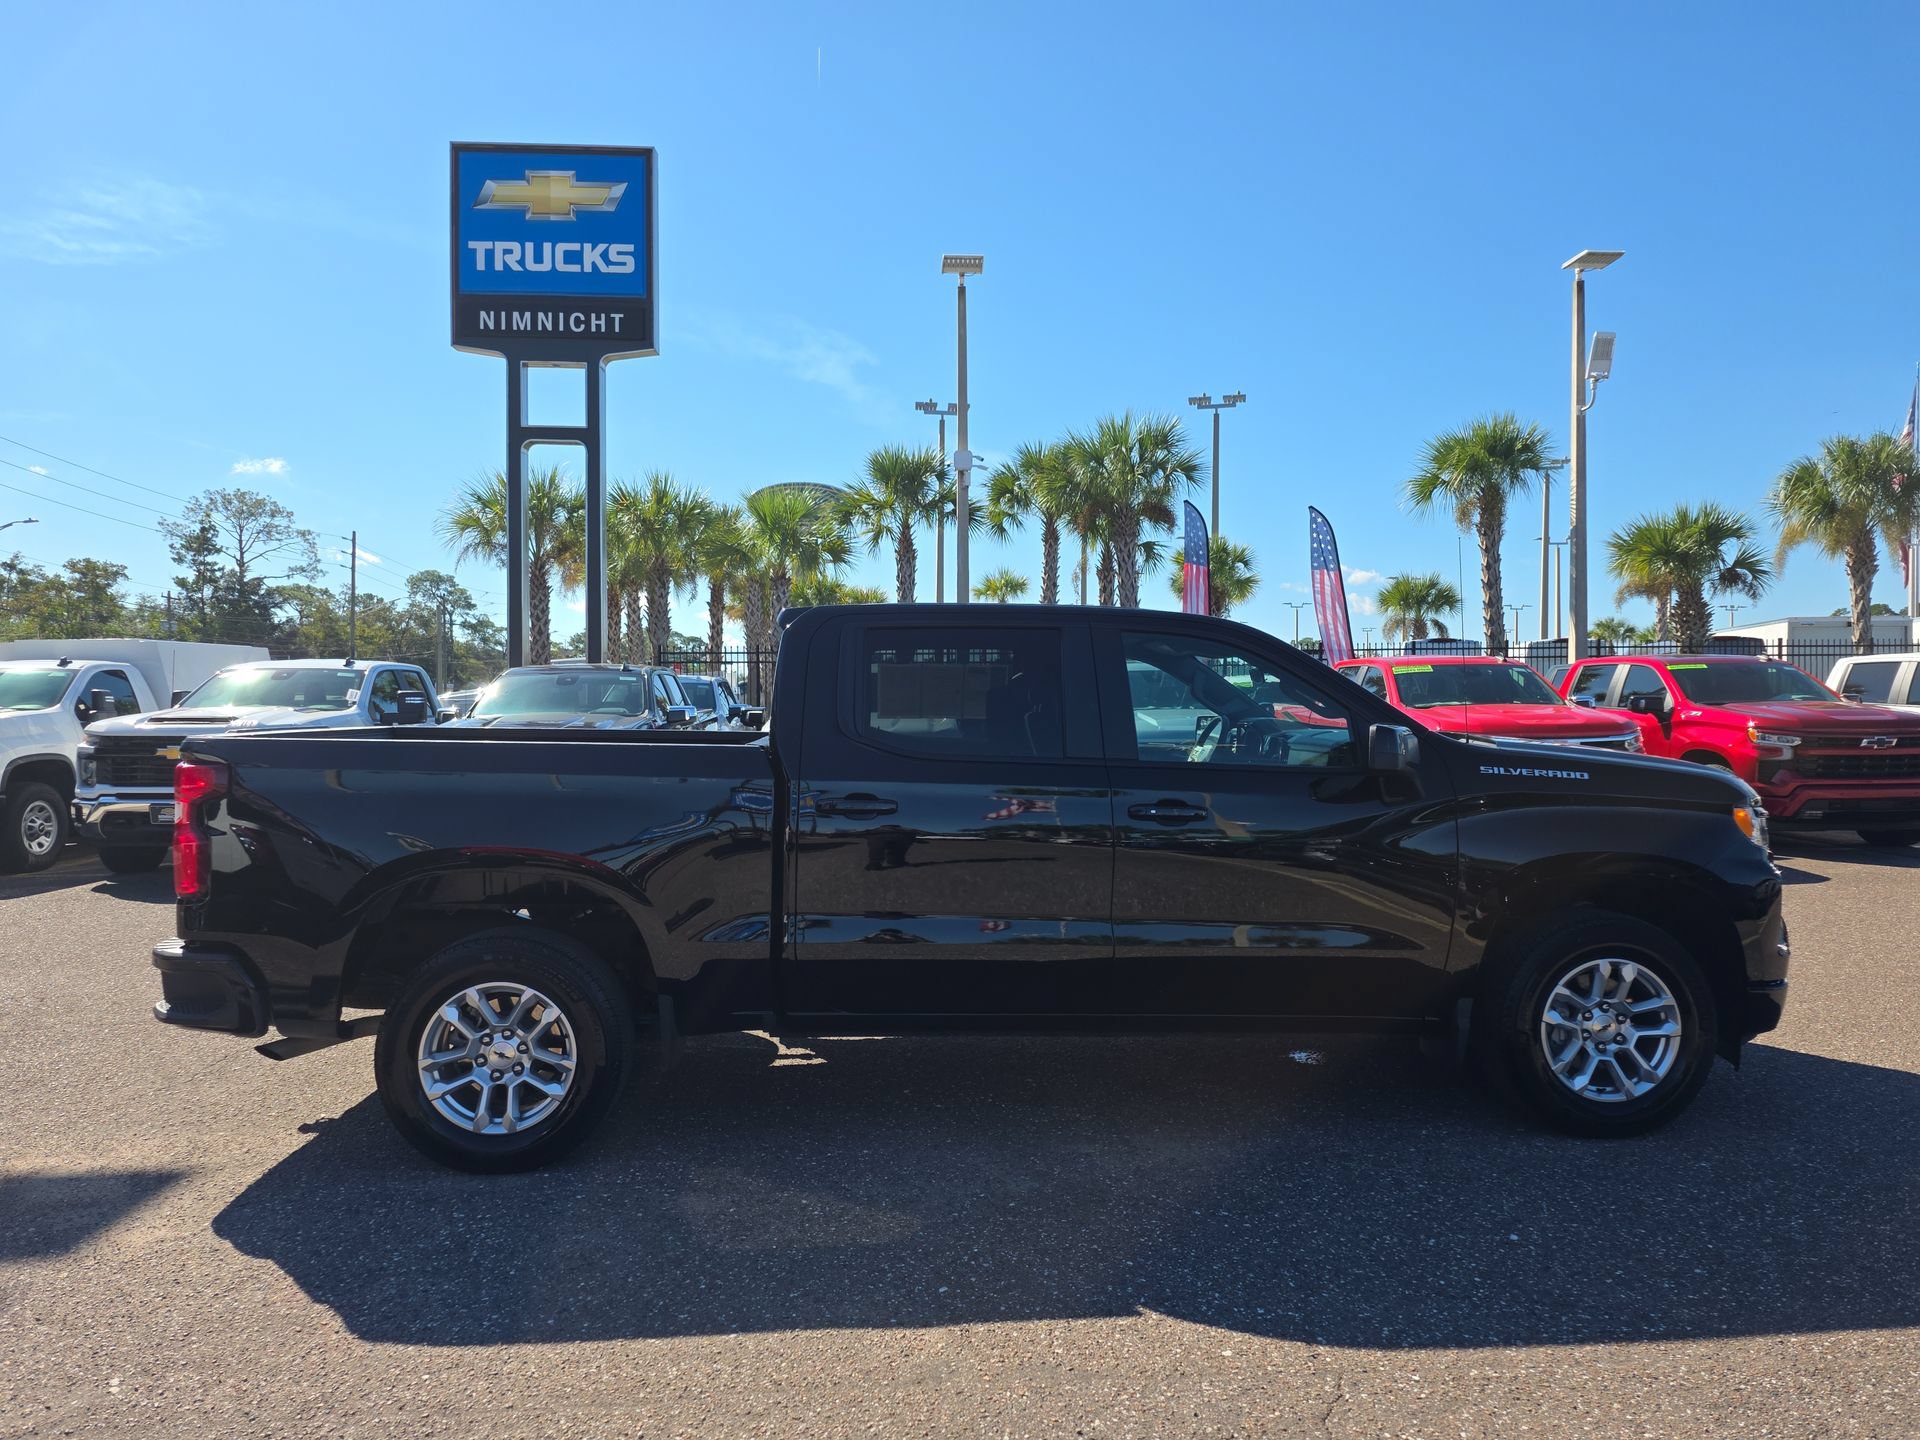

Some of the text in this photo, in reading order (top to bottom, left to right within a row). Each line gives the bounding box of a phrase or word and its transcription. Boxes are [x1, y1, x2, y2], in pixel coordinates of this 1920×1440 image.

[468, 241, 635, 273] TRUCKS
[479, 310, 624, 333] NIMNICHT
[1479, 765, 1589, 780] SILVERADO
